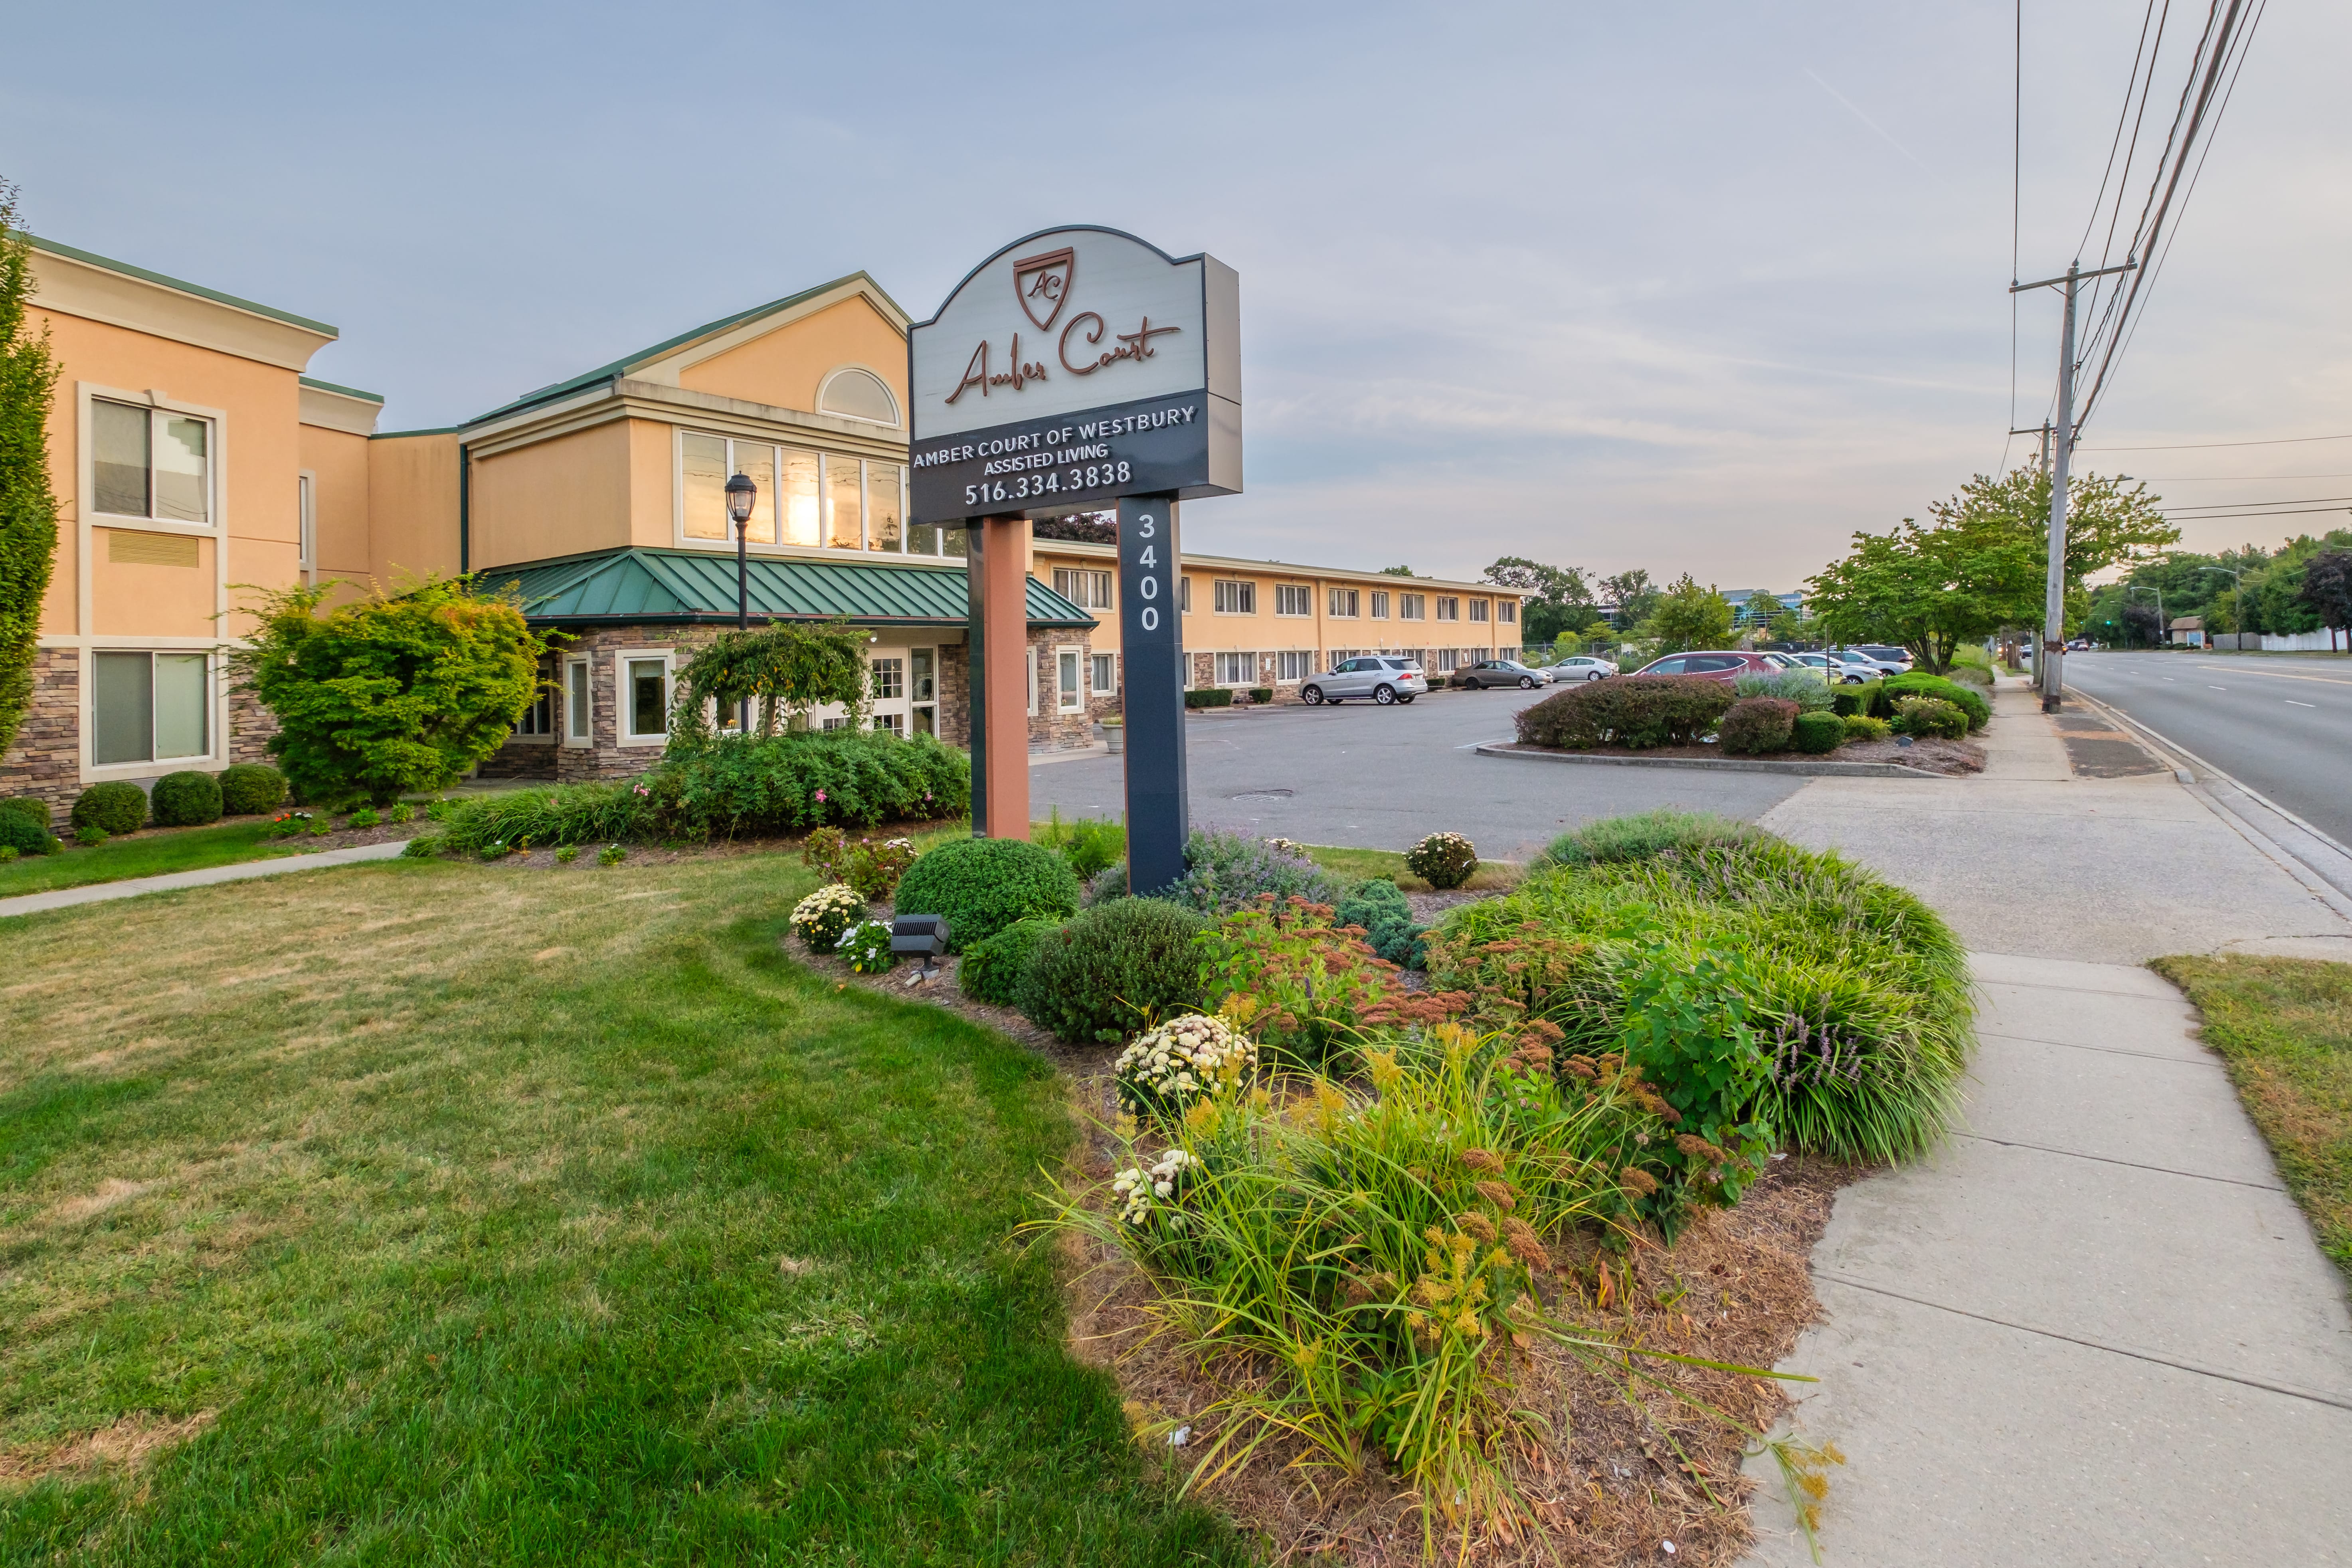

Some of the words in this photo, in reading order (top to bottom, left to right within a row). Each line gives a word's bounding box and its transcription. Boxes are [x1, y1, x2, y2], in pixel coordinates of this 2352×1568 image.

[1027, 271, 1061, 299] AC
[945, 332, 1046, 403] Amber
[1058, 311, 1181, 374] Court
[914, 445, 975, 468] AMBER
[978, 433, 1041, 456] COURT
[1047, 427, 1073, 445] OF
[1079, 406, 1195, 439] WESTBURY
[984, 453, 1054, 476] ASSISTED
[1058, 443, 1108, 464] LIVING
[965, 461, 1131, 504] 516.334.3838
[1139, 514, 1158, 630] 3400
